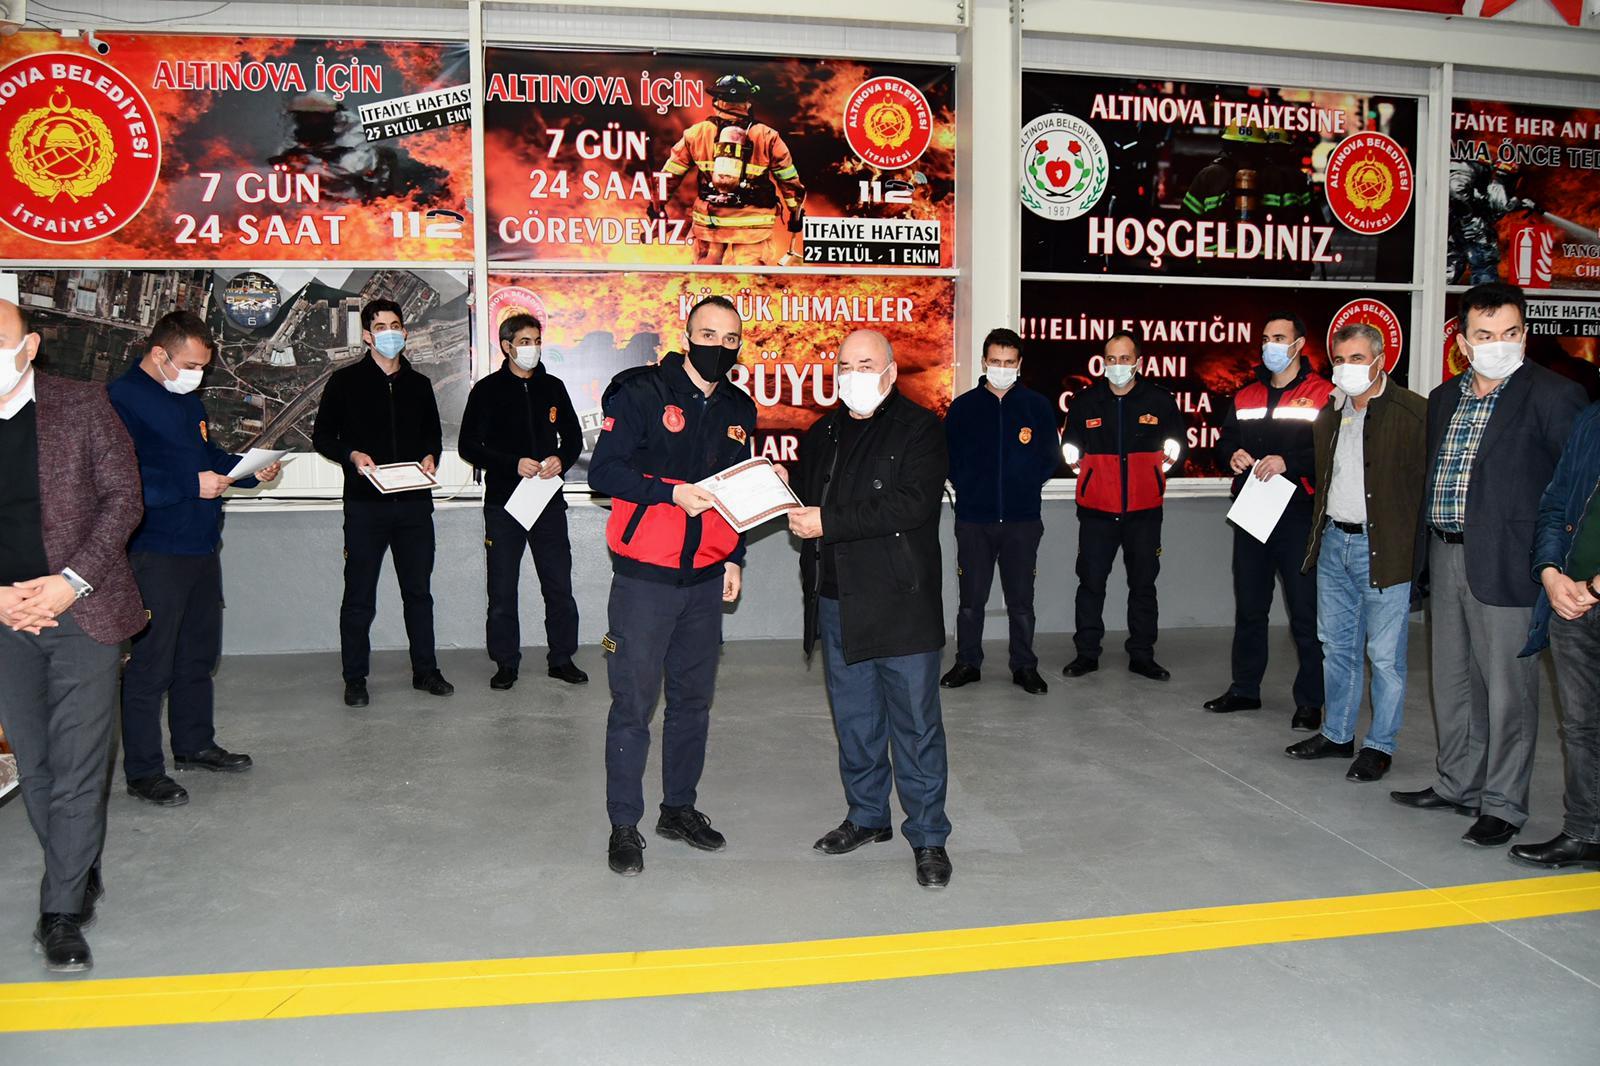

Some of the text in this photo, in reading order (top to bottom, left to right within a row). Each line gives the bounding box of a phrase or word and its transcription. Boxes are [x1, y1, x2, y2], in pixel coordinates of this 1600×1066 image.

[152, 56, 383, 101] ALTINOVA İÇİN
[486, 70, 704, 115] ALTINOVA İÇİN
[51, 63, 153, 159] BELEDİYESİ
[360, 101, 413, 123] İTFAİYE
[849, 82, 929, 131] ALTINOVA BELEDİYESİ
[1090, 94, 1346, 134] ALTINOVA İTFAİYESİNE
[365, 126, 381, 141] 25
[384, 116, 424, 137] EYLÜL
[435, 114, 442, 126] 1
[1056, 118, 1102, 155] BELEDİYESİ
[1451, 110, 1508, 133] FAİYE
[1515, 117, 1554, 137] HER
[1560, 120, 1588, 140] AN
[546, 122, 647, 161] 7 GÜN
[864, 147, 912, 164] İTFAİYESİ
[1497, 137, 1561, 167] ÖNCE
[1330, 137, 1409, 191] ALTINOVA BELEDİYESİ
[200, 164, 320, 204] 7 GÜN
[529, 169, 673, 201] 24 SAAT
[12, 203, 117, 234] İTFAİYESİ
[174, 214, 346, 246] 24 SAAT
[498, 209, 694, 246] GÖREVDEYİZ.
[804, 219, 939, 242] İTFAİYE HAFTASI
[804, 246, 822, 262] 25
[827, 243, 873, 263] EYLÜL
[889, 246, 896, 263] 1
[903, 245, 940, 264] EKİM
[1088, 213, 1344, 268] HOŞGELDİNİZ.
[1562, 243, 1600, 259] YANG
[679, 287, 914, 322] KÜK İHMALLER
[248, 317, 257, 326] 6
[1139, 315, 1251, 343] YAKTIĞIN
[1362, 304, 1399, 347] BELEDİYESİ
[1532, 320, 1563, 335] EYLÜL
